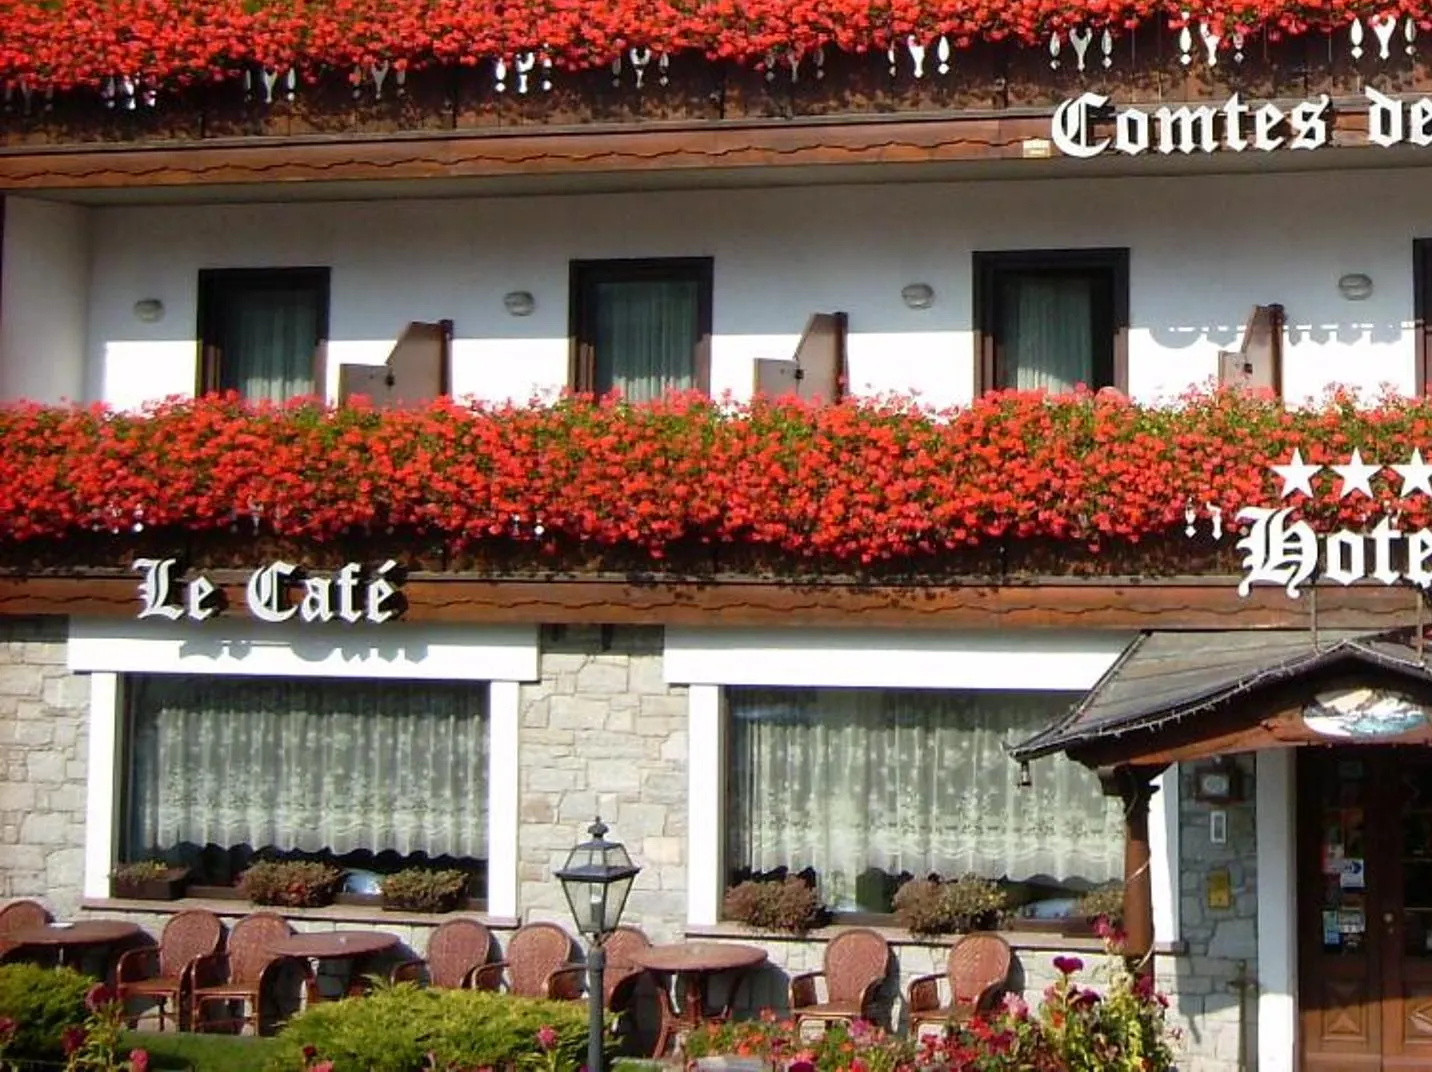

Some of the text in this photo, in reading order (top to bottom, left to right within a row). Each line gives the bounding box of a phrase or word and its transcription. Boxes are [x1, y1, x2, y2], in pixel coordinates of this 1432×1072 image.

[1051, 91, 1331, 157] Comtes
[132, 558, 397, 623] Le Café
